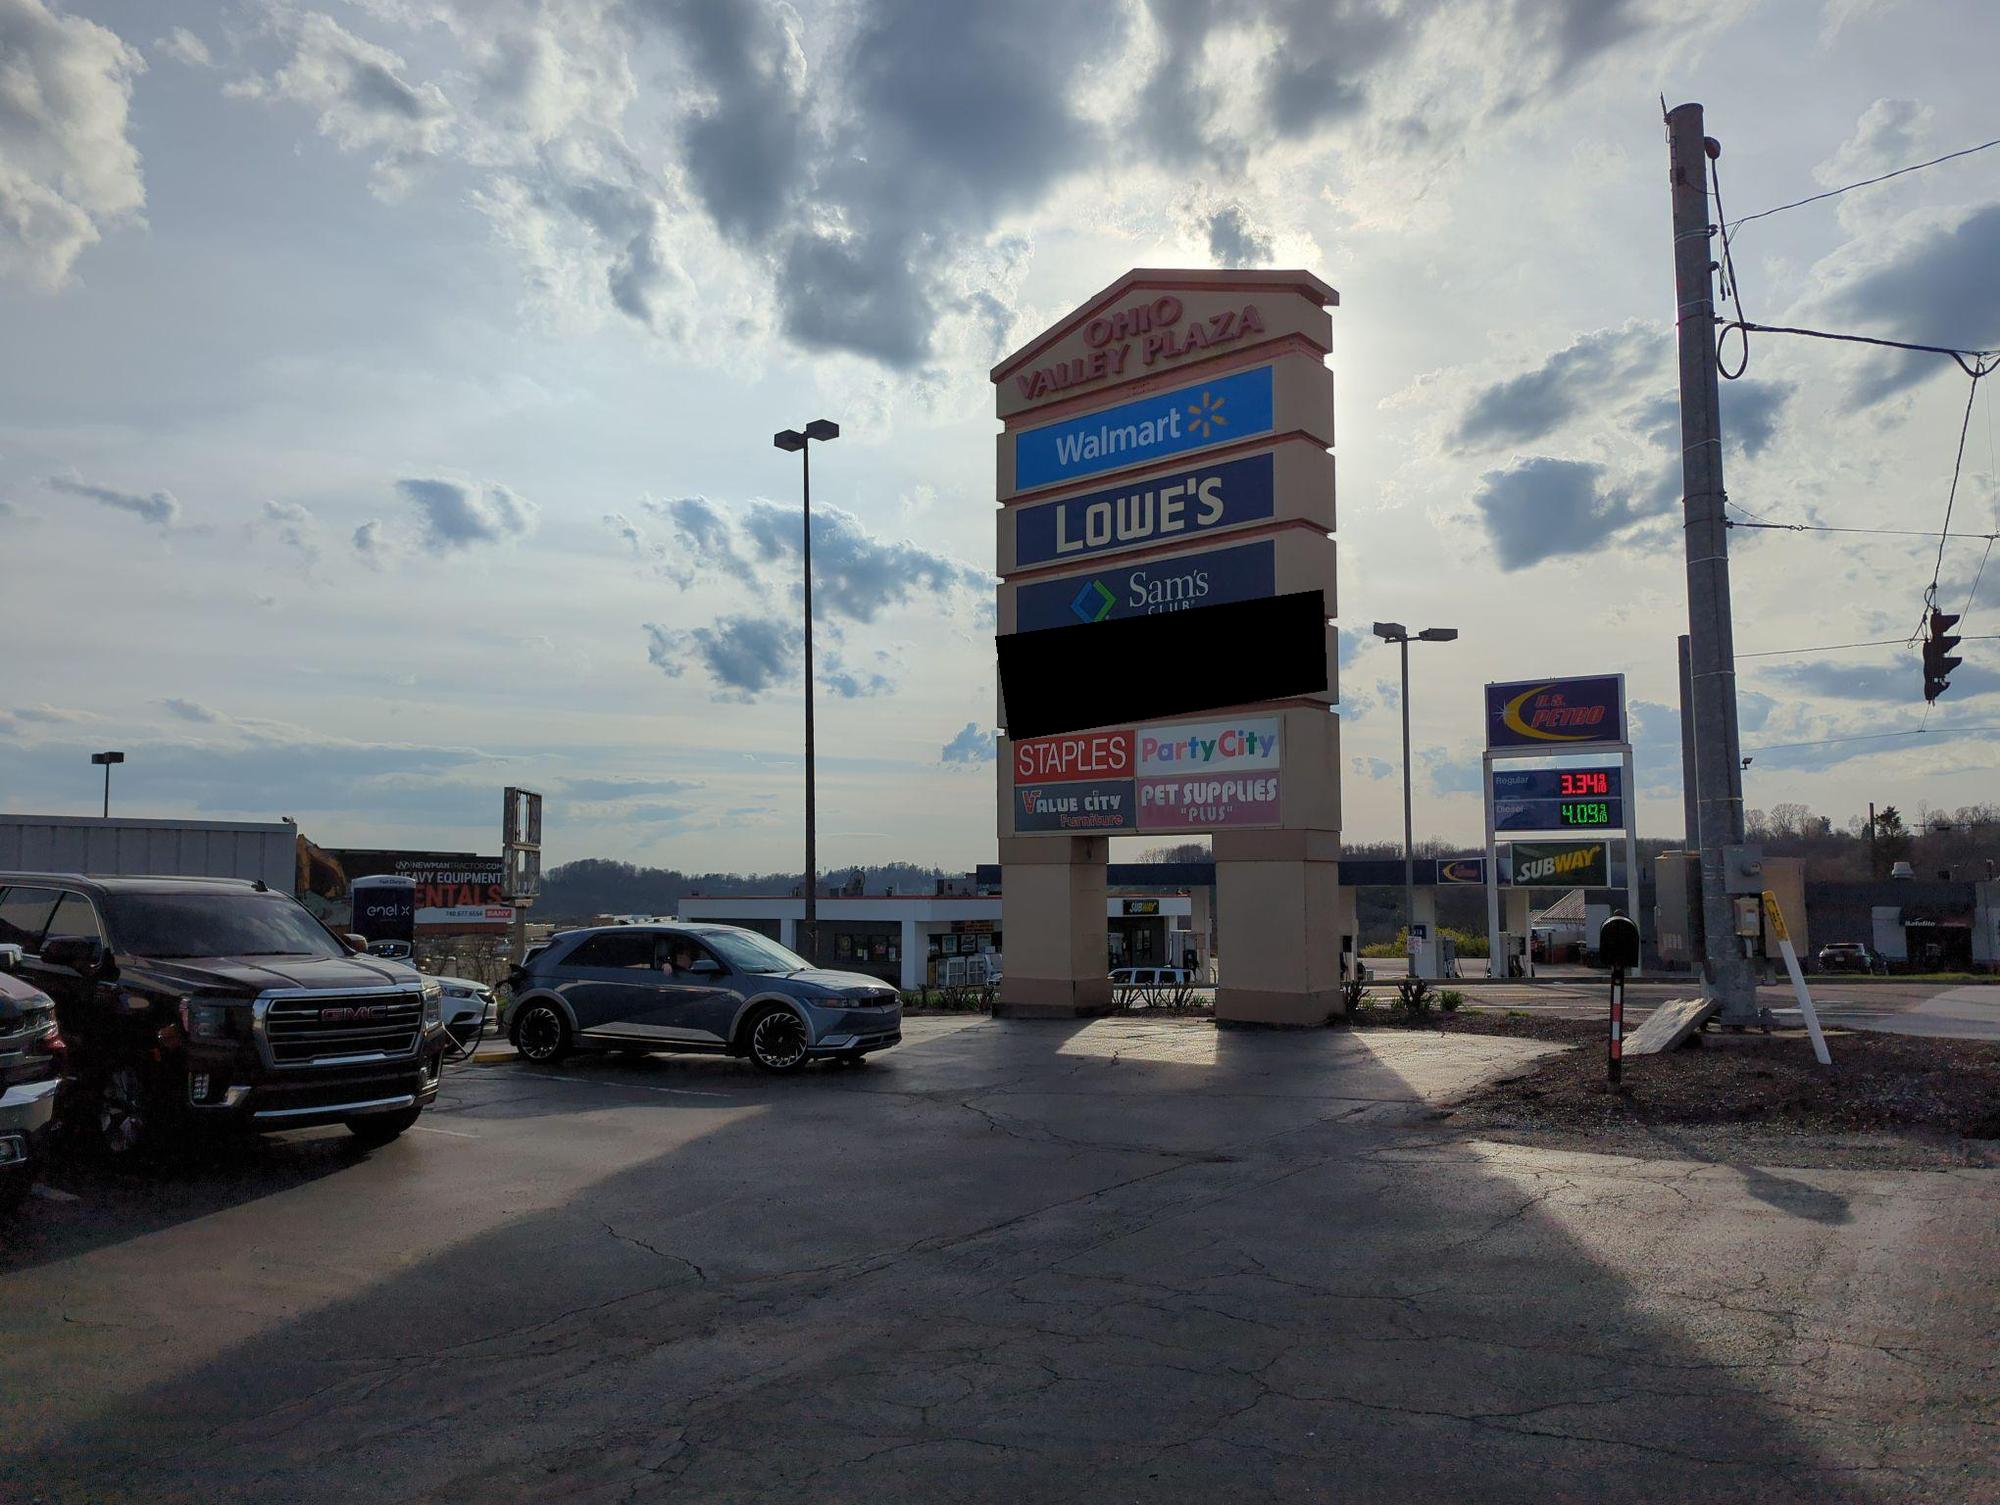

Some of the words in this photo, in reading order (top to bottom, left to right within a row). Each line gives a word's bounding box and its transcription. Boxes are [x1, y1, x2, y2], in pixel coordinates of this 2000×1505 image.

[1083, 295, 1184, 348] OHIO
[1015, 344, 1131, 400] VALLEY
[1141, 304, 1265, 366] PLAZA
[1056, 407, 1181, 466] Walmart
[1056, 477, 1224, 553] LOWE'S
[1129, 570, 1209, 608] Sam's
[1531, 705, 1605, 728] PETRO
[1019, 736, 1127, 776] STAPLES
[1142, 783, 1179, 806] PET
[1183, 778, 1277, 806] SUPPLIES
[1496, 775, 1529, 786] Regular
[1021, 790, 1078, 814] VALUE
[437, 871, 501, 884] EQUIPMENT
[1517, 845, 1602, 882] SUBWAY
[415, 883, 504, 908] ENTALS
[367, 903, 398, 917] enel
[321, 1005, 386, 1021] GMC
